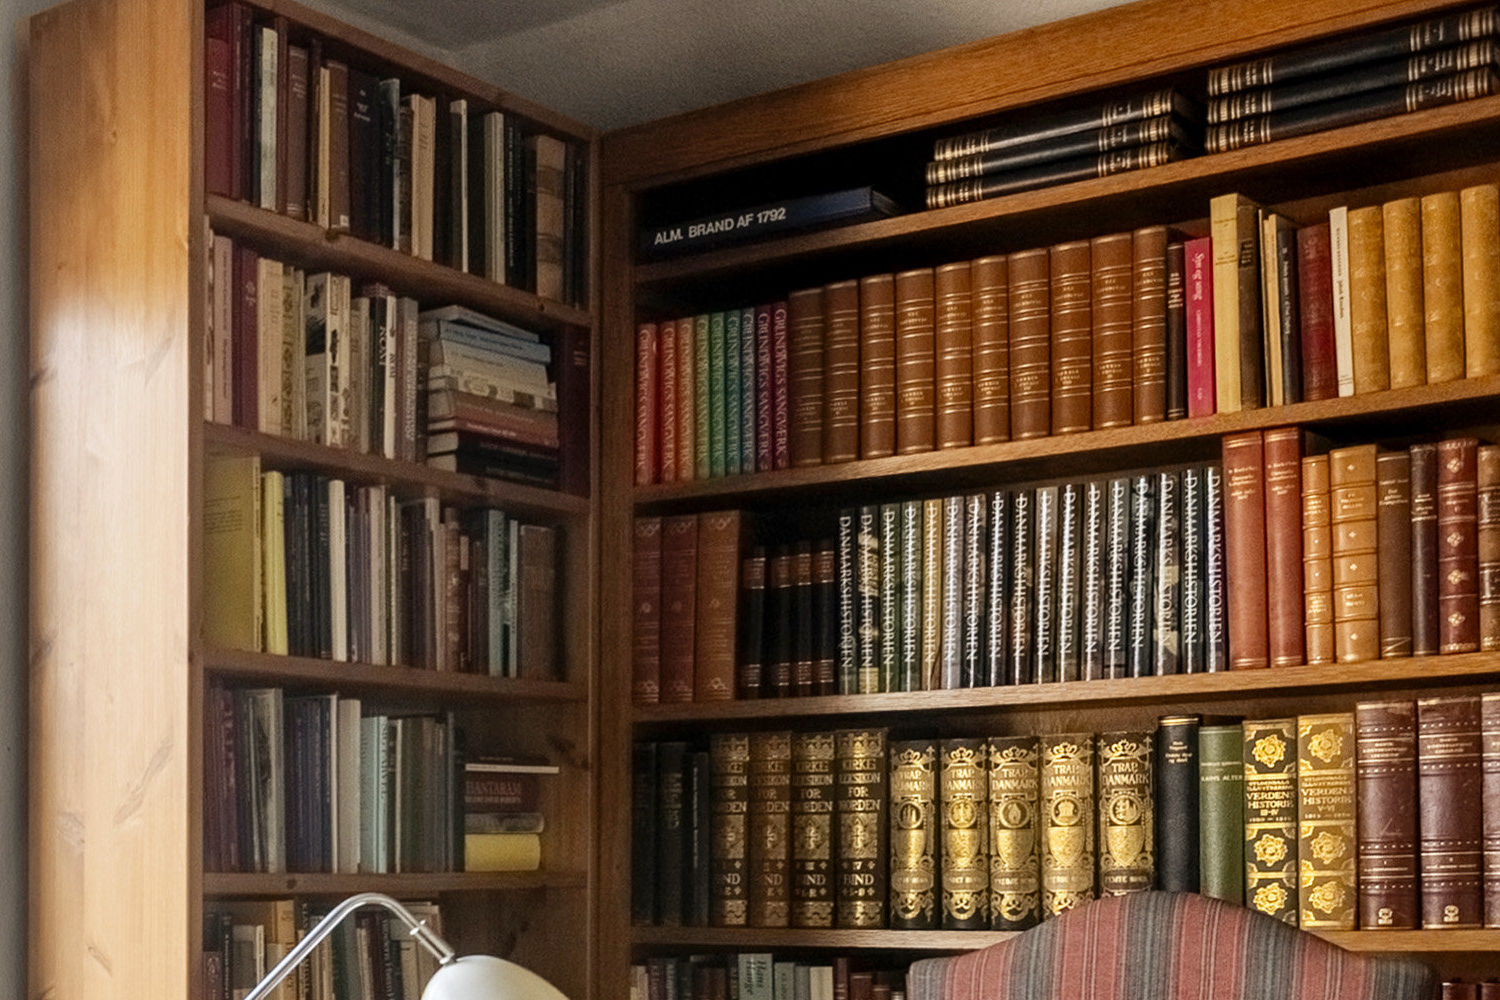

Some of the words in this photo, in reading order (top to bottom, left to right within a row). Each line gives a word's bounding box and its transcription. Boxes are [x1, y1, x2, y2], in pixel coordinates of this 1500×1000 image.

[654, 228, 684, 245] ALM.
[688, 218, 735, 238] BRAND
[736, 213, 754, 229] AF
[756, 207, 787, 224] 1792
[774, 308, 787, 384] GRUNDTVIGS
[839, 516, 852, 667] DANMARKSHISTORIEN
[883, 510, 895, 664] DANMARKSHISTORIEN
[1184, 476, 1198, 643] DANMARKSHISTORIEN
[1208, 475, 1222, 643] DANMARKSHISTORIEN
[848, 786, 869, 798] FOR
[1102, 773, 1150, 786] DANMARK
[1112, 762, 1139, 773] TRAP
